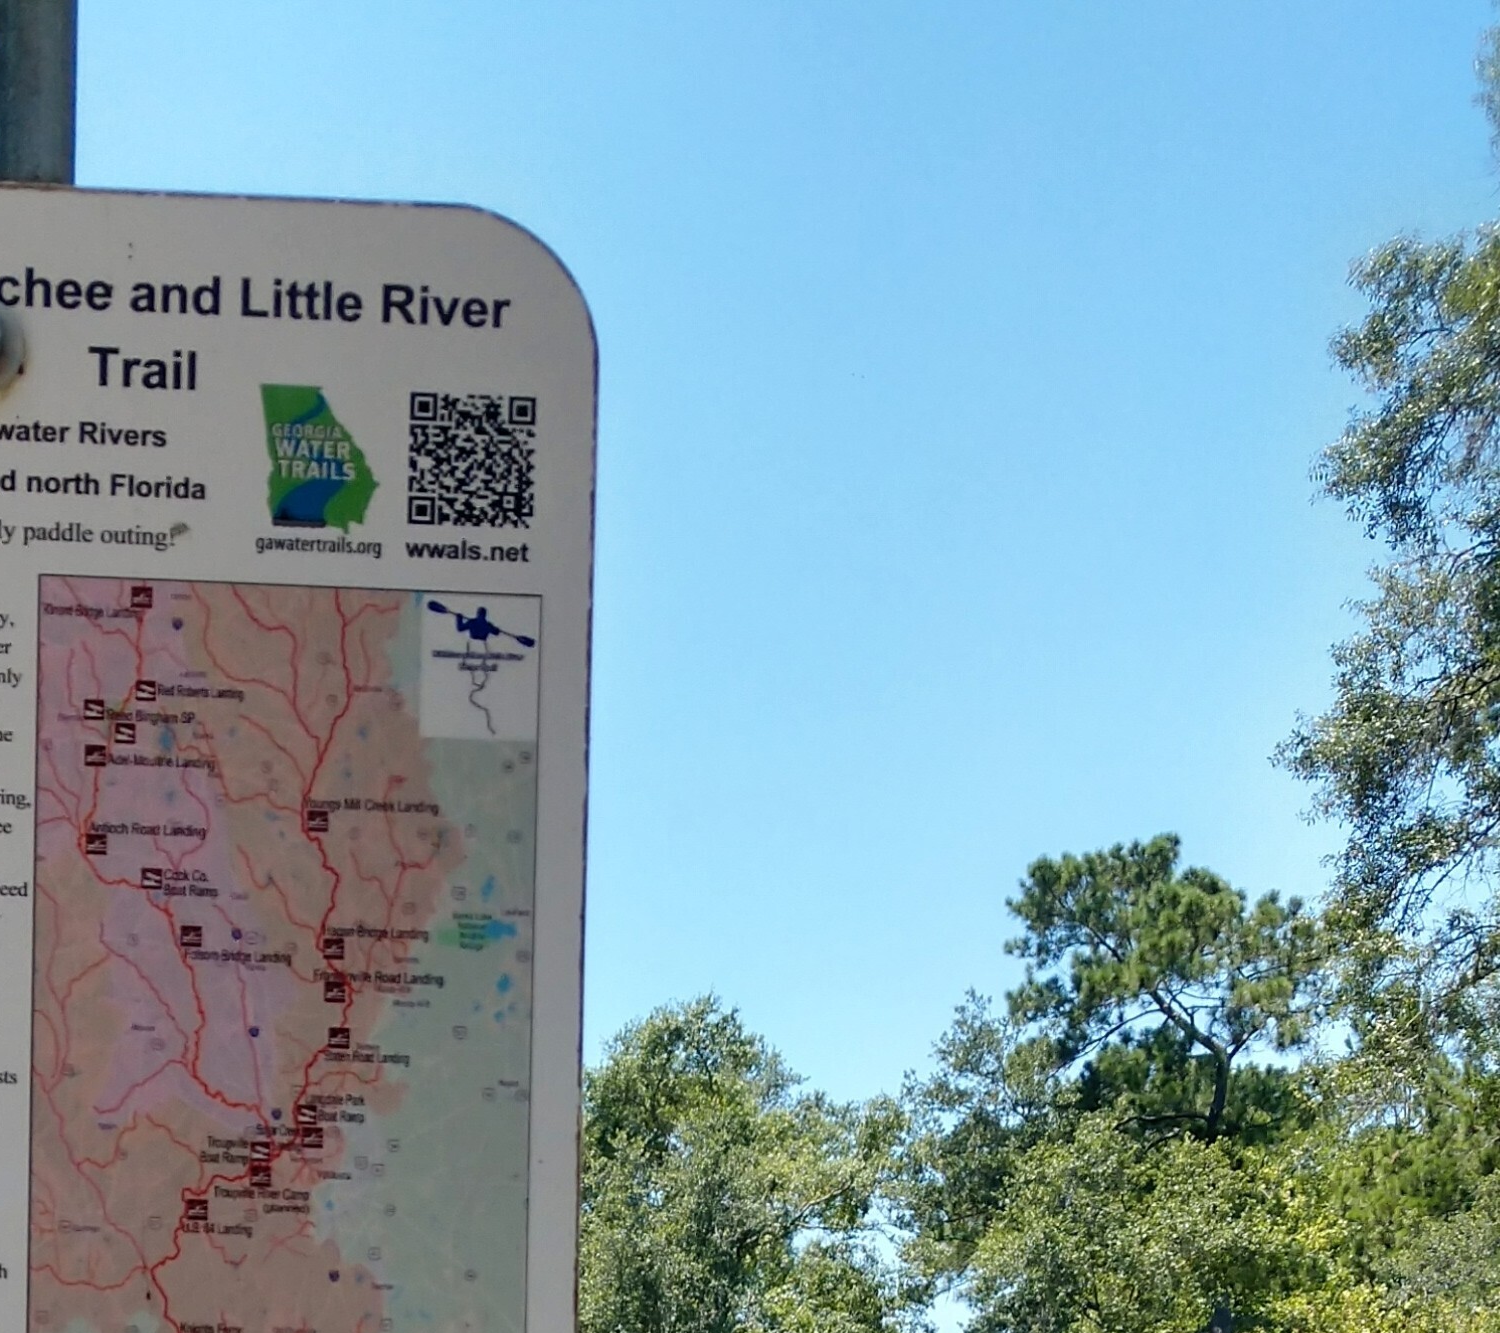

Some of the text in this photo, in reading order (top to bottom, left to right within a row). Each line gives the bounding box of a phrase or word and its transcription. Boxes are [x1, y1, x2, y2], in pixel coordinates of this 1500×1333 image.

[129, 275, 221, 316] and
[240, 277, 363, 323] Little
[381, 283, 512, 329] River
[87, 346, 197, 391] Trail
[78, 421, 167, 448] Rivers
[272, 423, 342, 439] GEORGIA
[275, 440, 351, 459] WATER
[278, 460, 356, 480] TRAILS
[26, 472, 100, 496] north
[110, 473, 206, 500] Florida
[23, 521, 95, 547] paddle
[100, 523, 176, 550] outing!
[255, 536, 382, 558] gawatertrails.org
[405, 539, 530, 562] wwals.net
